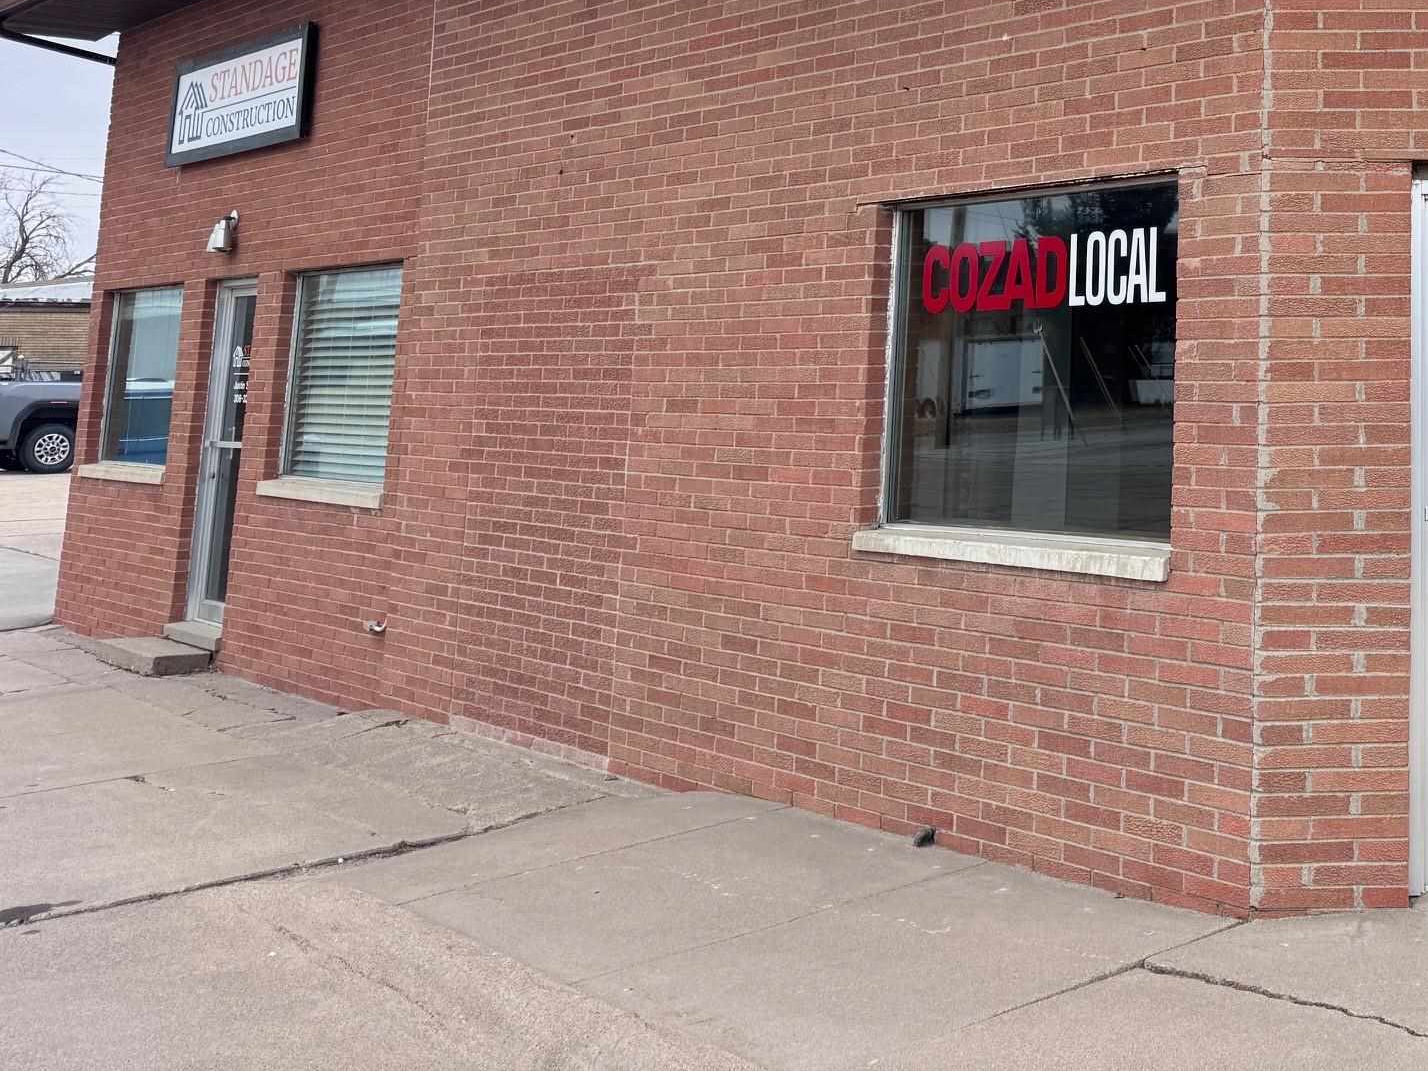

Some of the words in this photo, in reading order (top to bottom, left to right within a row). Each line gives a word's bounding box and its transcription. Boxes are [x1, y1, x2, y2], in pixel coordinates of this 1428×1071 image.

[208, 47, 299, 103] STANDAGE
[205, 95, 296, 138] CONSTRUCTION
[921, 235, 1068, 315] COZAD
[1068, 226, 1166, 307] LOCAL
